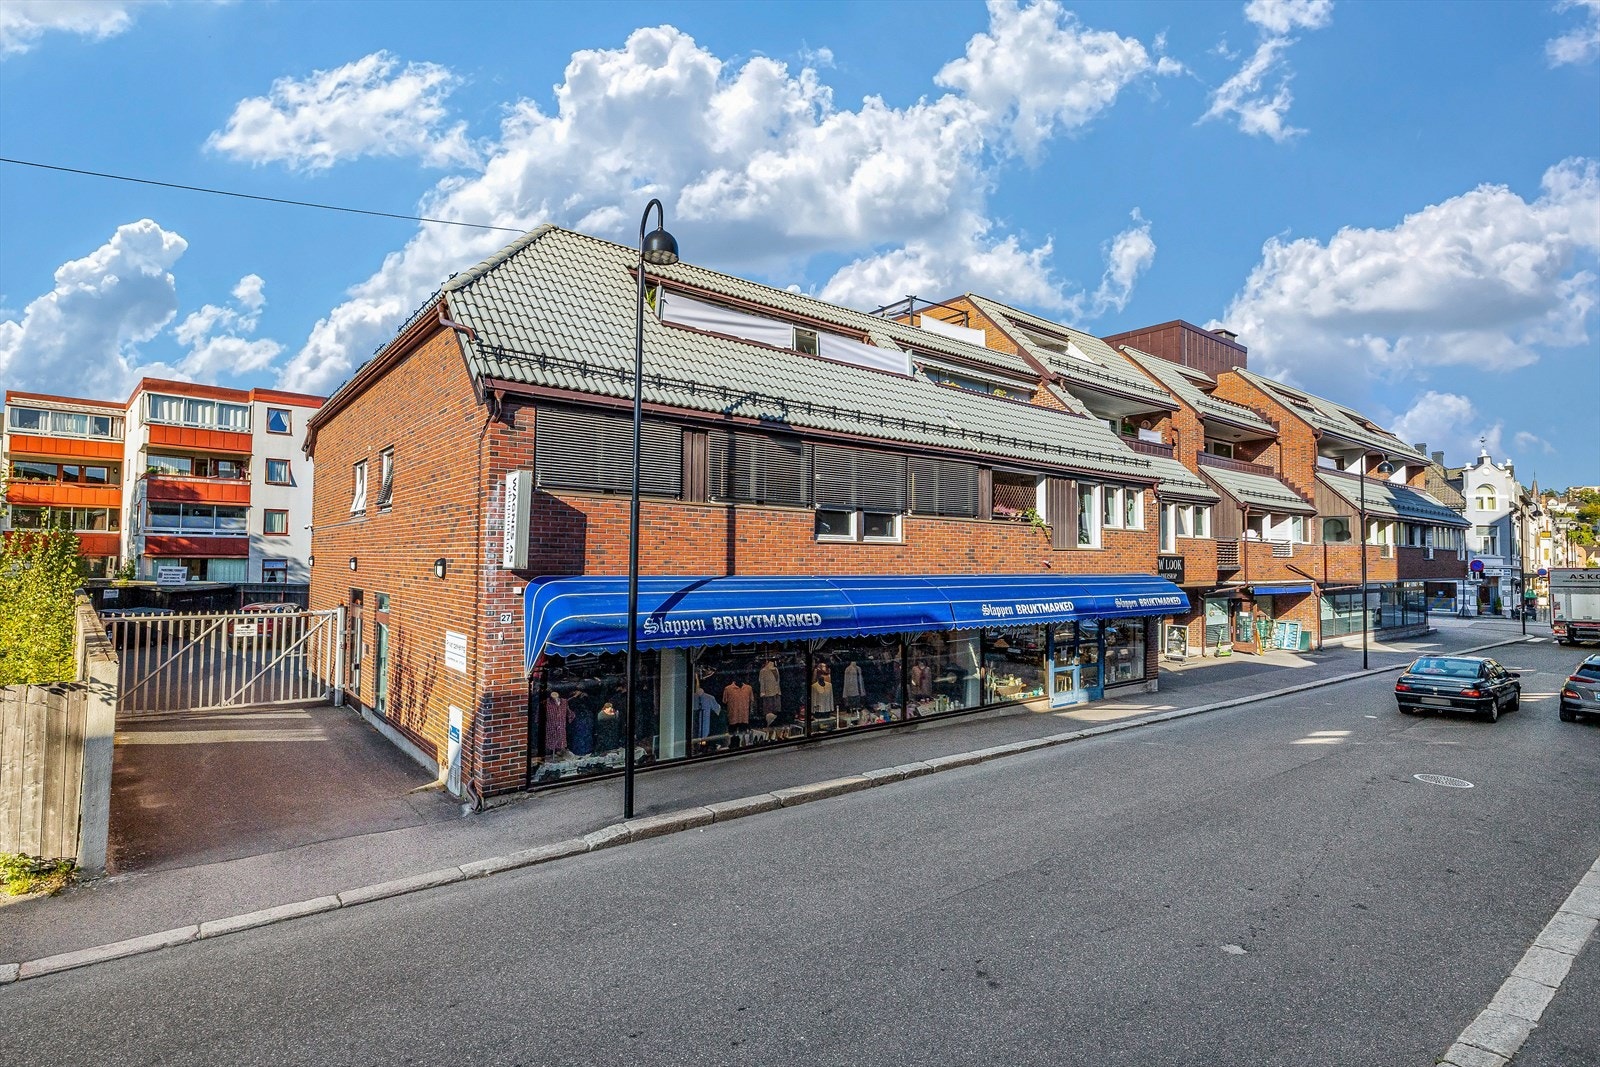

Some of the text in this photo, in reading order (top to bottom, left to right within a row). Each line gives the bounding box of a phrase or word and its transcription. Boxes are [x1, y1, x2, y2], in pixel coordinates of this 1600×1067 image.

[1165, 559, 1183, 571] LOOK
[982, 601, 1075, 617] Slappen BRUKTMARKED
[1115, 596, 1182, 609] Slappen BRUKTMARKED
[501, 614, 511, 622] 27
[643, 613, 822, 635] Slappen BRUKTMARKED
